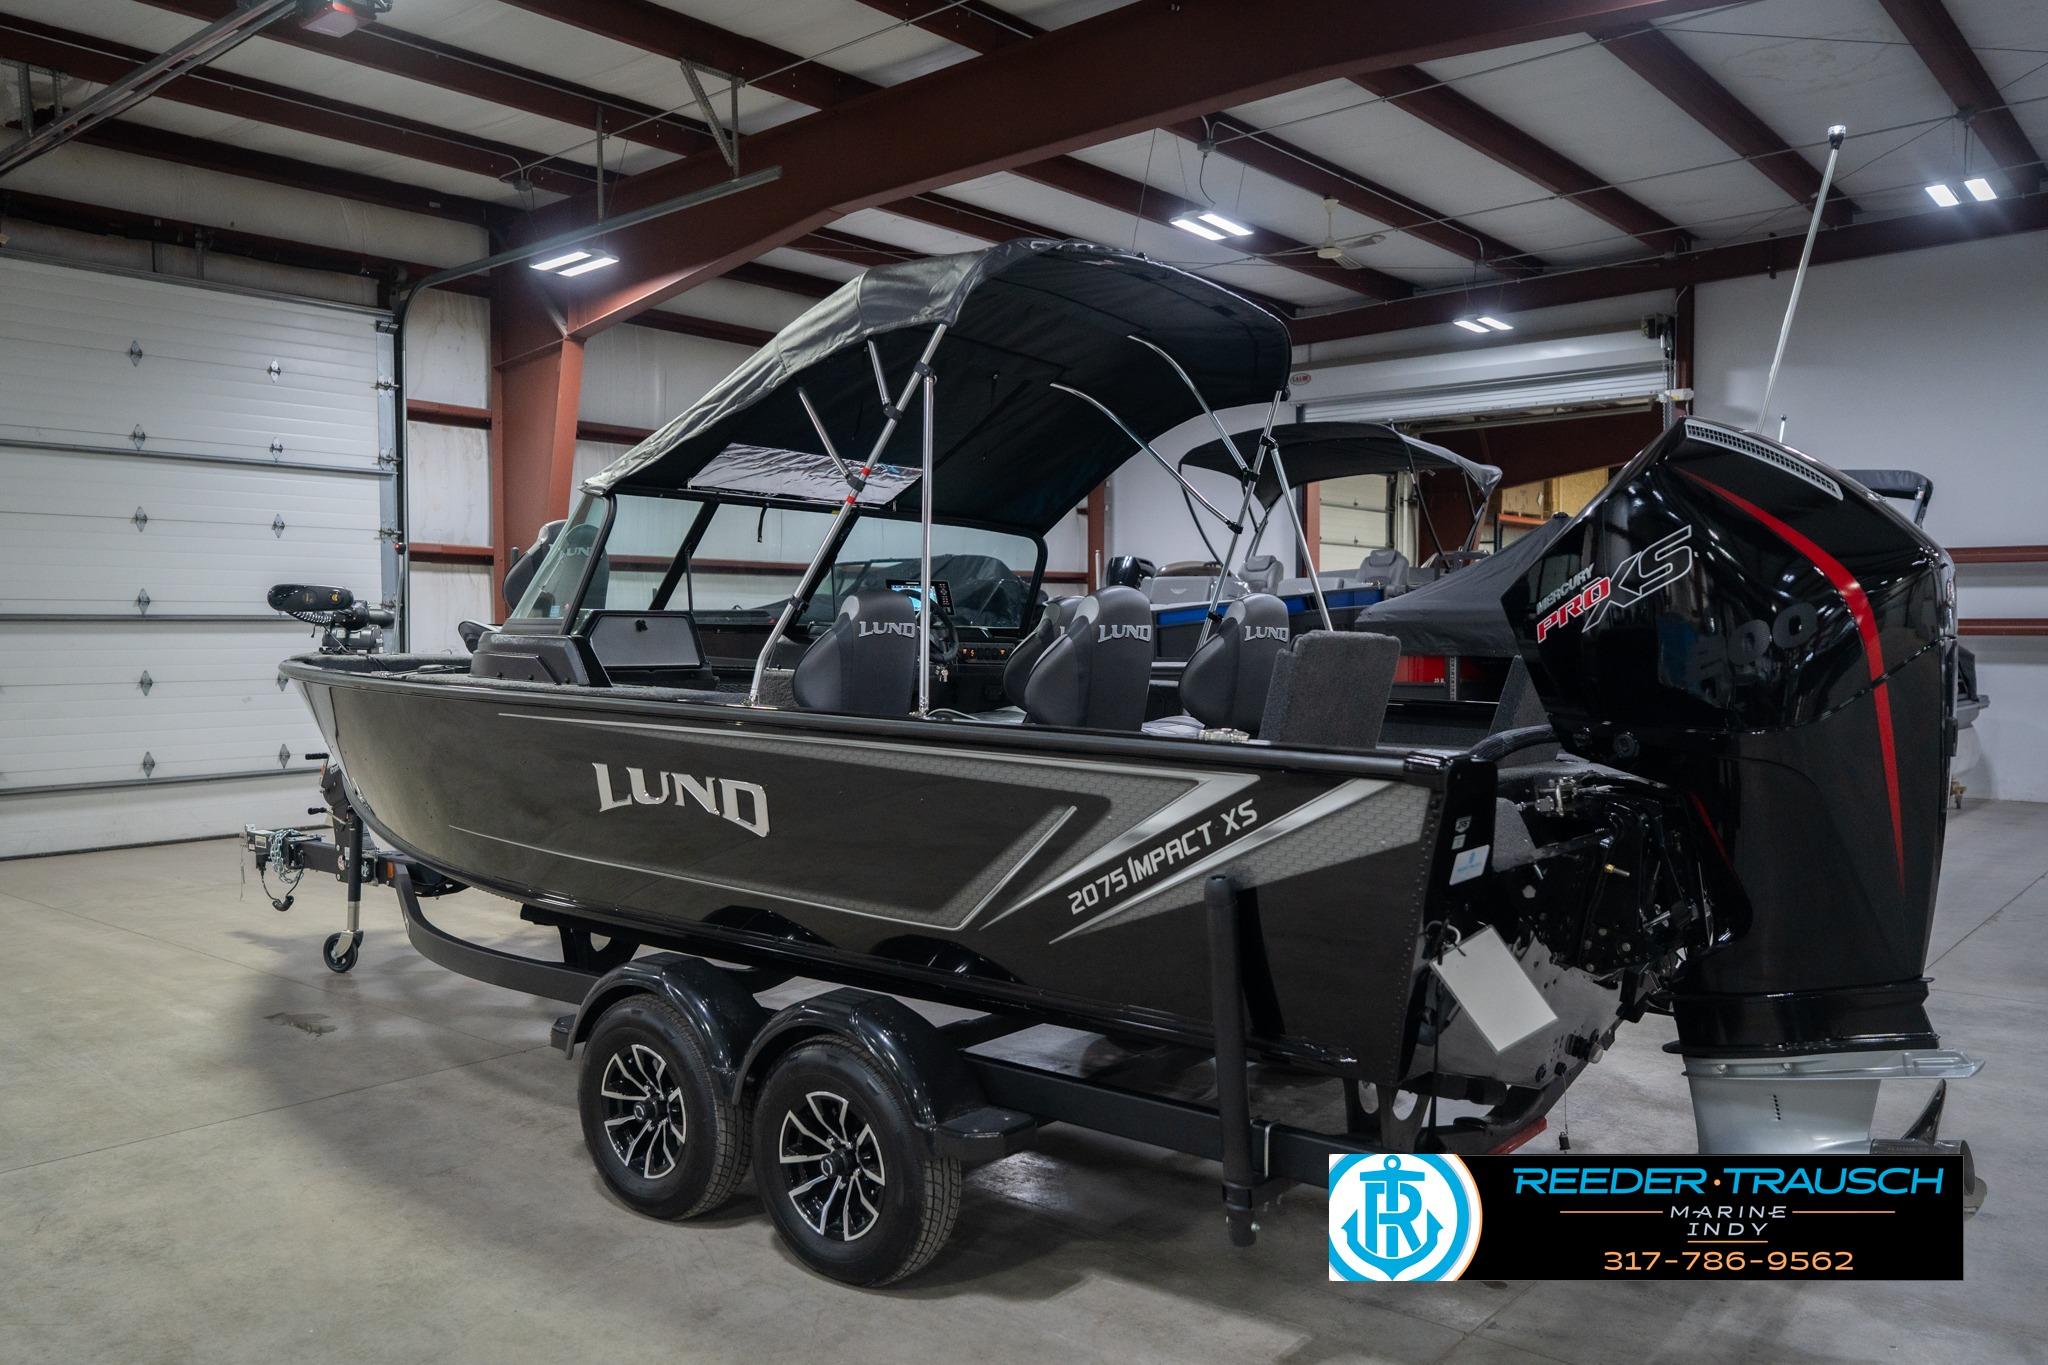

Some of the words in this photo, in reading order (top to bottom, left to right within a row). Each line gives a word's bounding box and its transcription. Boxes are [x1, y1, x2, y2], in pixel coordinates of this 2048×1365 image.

[1536, 563, 1595, 615] MERCURY
[1537, 577, 1611, 644] PRO
[1582, 525, 1692, 633] XS
[858, 621, 917, 639] LUND
[1098, 624, 1152, 643] LUND
[1244, 625, 1290, 643] LUND
[592, 762, 770, 837] LUND
[1067, 867, 1128, 915] 2075
[1127, 820, 1213, 884] IMPACT
[1220, 798, 1258, 836] XS
